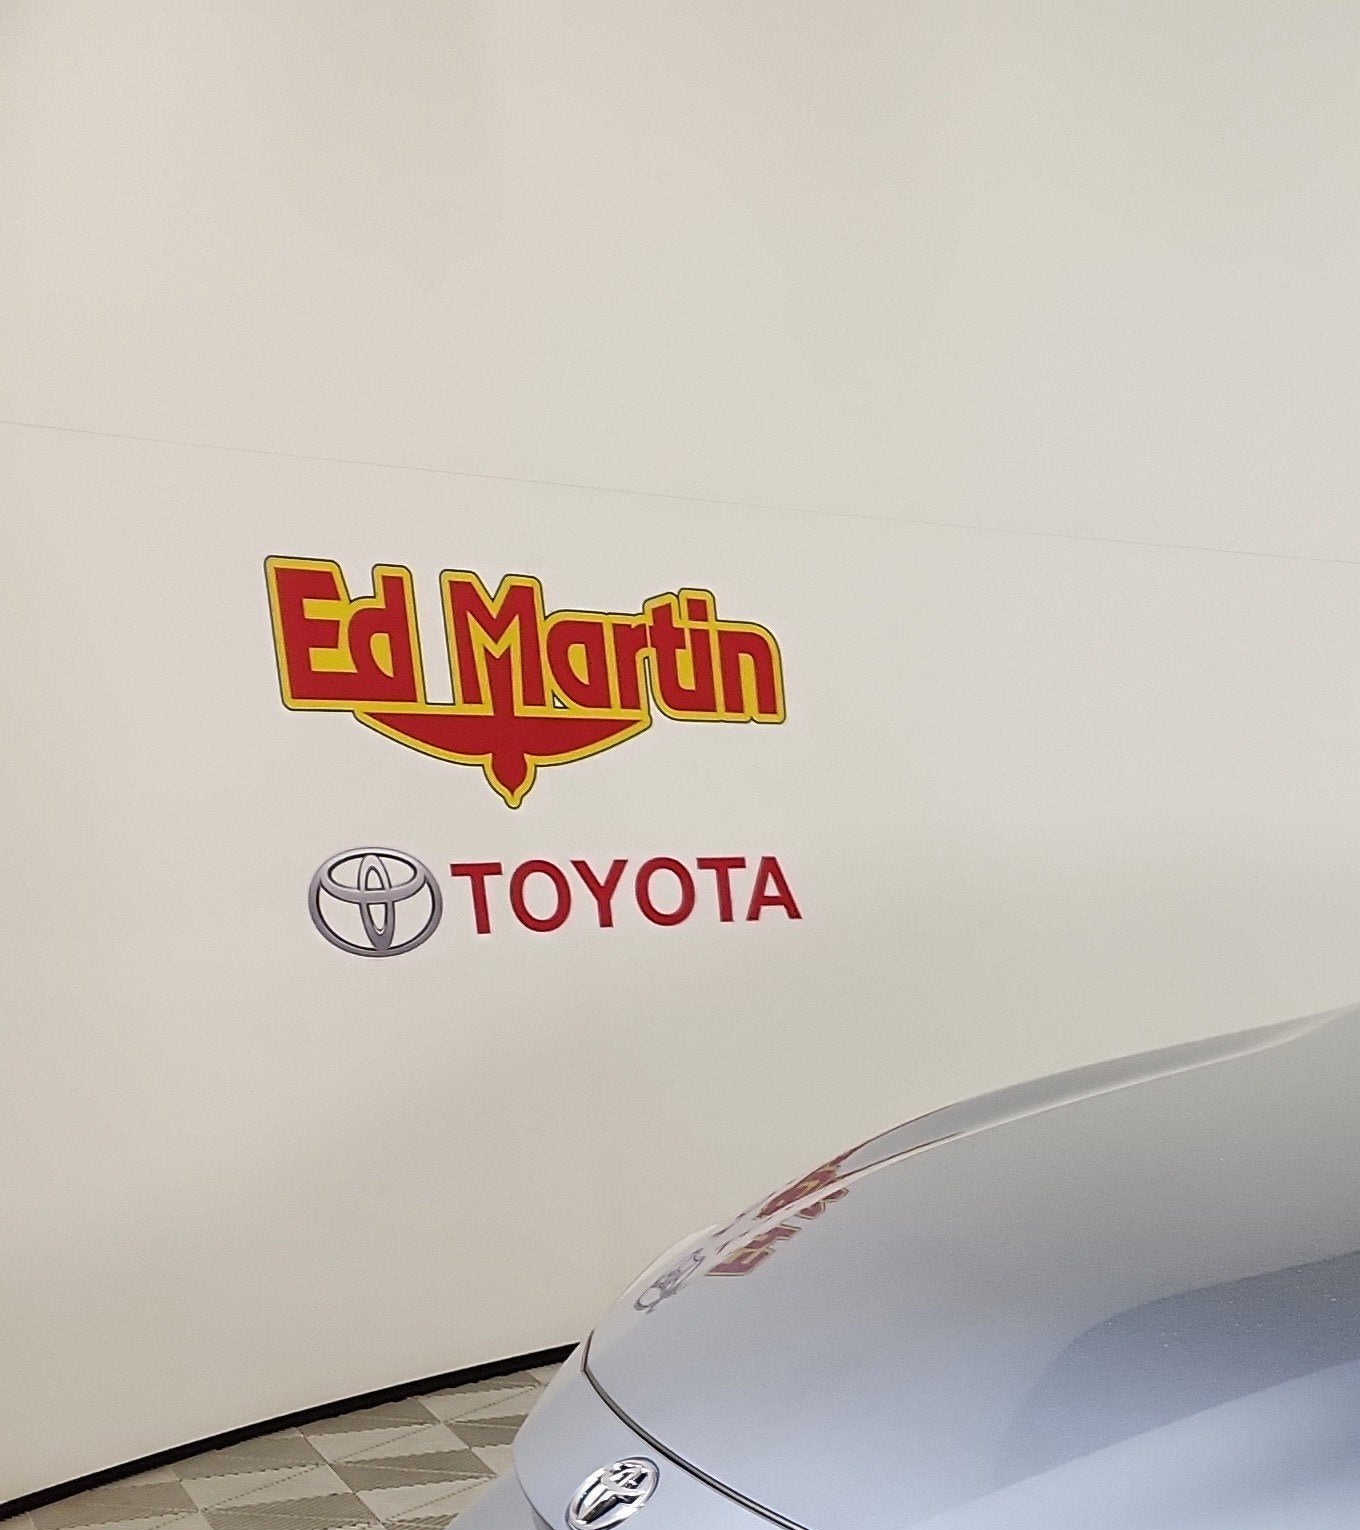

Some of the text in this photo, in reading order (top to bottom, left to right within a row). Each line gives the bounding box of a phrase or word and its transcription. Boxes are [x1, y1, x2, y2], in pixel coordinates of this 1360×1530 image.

[265, 555, 786, 724] Ed Martin
[450, 856, 802, 935] TOYOTA
